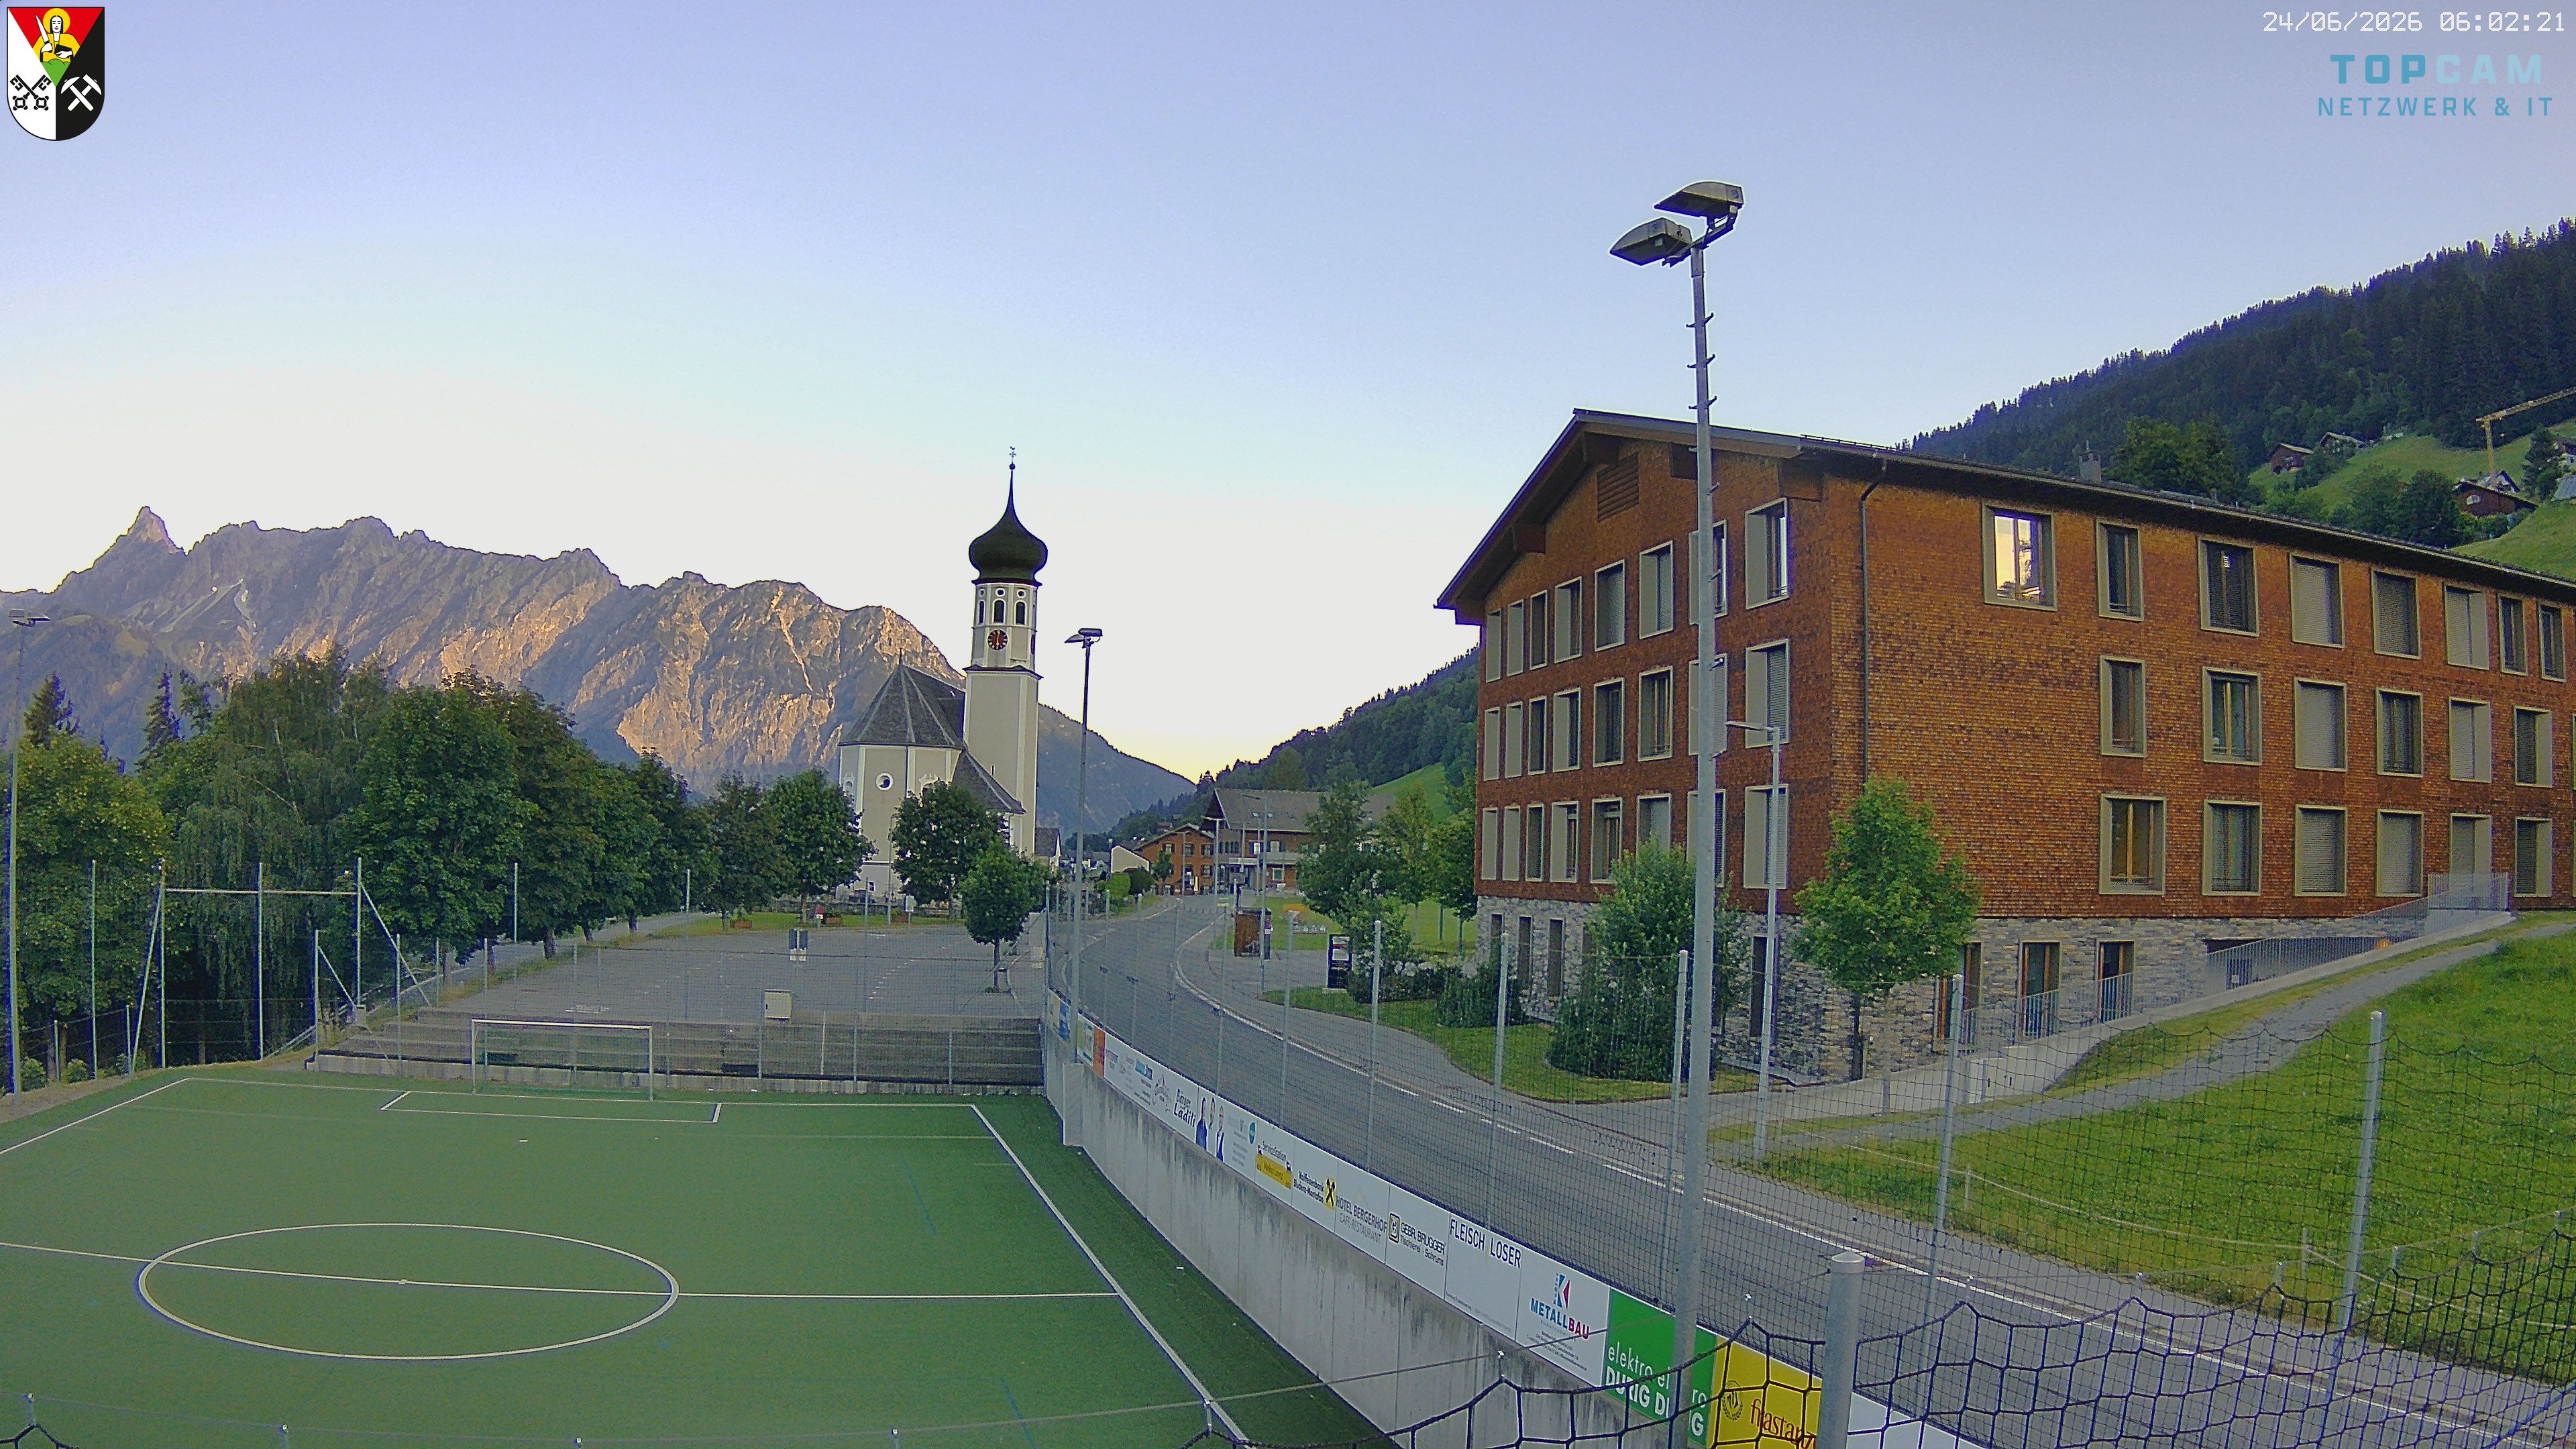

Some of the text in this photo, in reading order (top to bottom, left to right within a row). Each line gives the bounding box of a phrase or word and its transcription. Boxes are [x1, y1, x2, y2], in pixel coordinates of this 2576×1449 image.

[1336, 1195, 1388, 1234] HOTEL BERGERHOF
[1450, 1219, 1521, 1269] FLEISCH LOSER
[1530, 1298, 1589, 1339] METALLBAU
[1608, 1342, 1653, 1377] elektro
